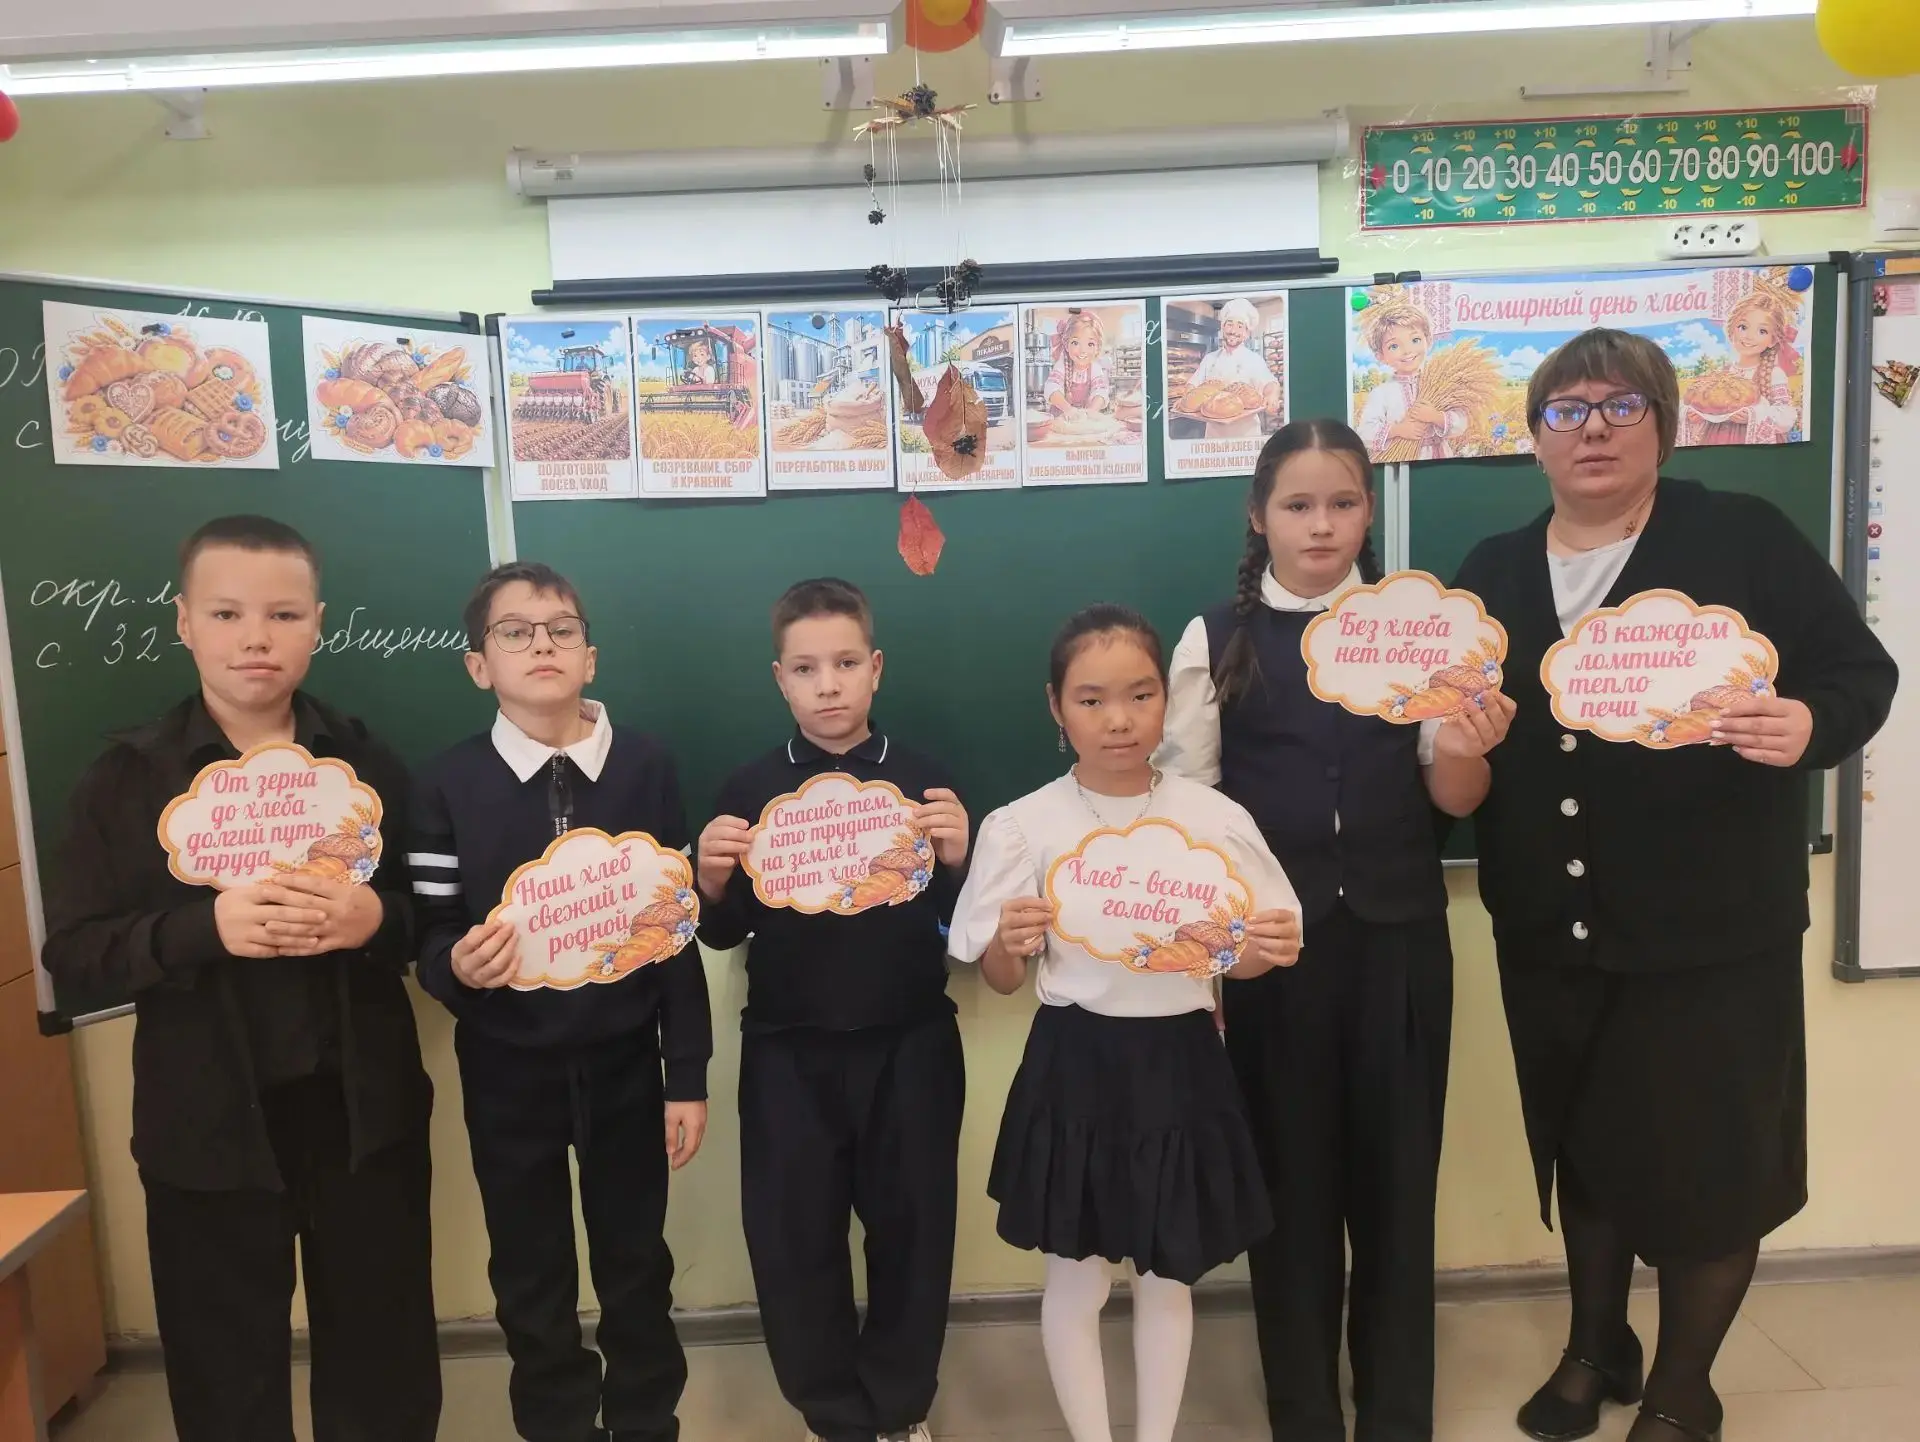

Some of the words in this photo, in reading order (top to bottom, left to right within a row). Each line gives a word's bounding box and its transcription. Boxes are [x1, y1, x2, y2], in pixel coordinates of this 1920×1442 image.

[1412, 132, 1434, 142] +10
[1453, 130, 1475, 140] +10
[1494, 129, 1516, 139] +10
[1534, 127, 1556, 137] +10
[1575, 126, 1597, 136] +10
[1657, 121, 1678, 132] +10
[1695, 120, 1716, 130] +10
[1736, 118, 1758, 128] +10
[1778, 117, 1799, 127] +10
[1393, 160, 1410, 193] 0
[1421, 158, 1451, 191] 10
[1463, 156, 1495, 190] 20
[1505, 154, 1536, 189] 30
[1545, 152, 1579, 187] 40
[1588, 151, 1622, 186] 50
[1628, 149, 1661, 184] 60
[1668, 148, 1700, 182] 70
[1707, 146, 1740, 180] 80
[1746, 144, 1779, 178] 90
[1786, 141, 1834, 176] 100
[1414, 208, 1434, 220] -10
[1456, 208, 1475, 218] -10
[1497, 206, 1516, 216] -10
[1537, 204, 1556, 215] -10
[1578, 203, 1596, 213] -10
[1616, 201, 1636, 211] -10
[1658, 200, 1677, 210] -10
[1696, 198, 1714, 208] -10
[1737, 196, 1756, 206] -10
[1779, 194, 1798, 204] -10
[1455, 290, 1584, 325] Всемирный
[1589, 293, 1638, 323] день
[1645, 283, 1709, 313] хлеба
[1232, 440, 1252, 451] ХЛЕБ
[725, 460, 752, 474] СБОР
[775, 460, 846, 473] ПЕРЕРАБОТКА
[850, 460, 856, 472] В
[858, 459, 886, 472] МУКУ
[541, 478, 578, 490] ПОСЕВ,
[581, 478, 608, 491] УХОД
[672, 476, 678, 488] И
[680, 476, 733, 488] ХРАНЕНИЕ
[1340, 612, 1379, 643] Без
[1384, 612, 1452, 638] хлеба
[1588, 620, 1608, 644] В
[1614, 622, 1729, 648] каждом
[1334, 647, 1380, 664] нет
[1385, 641, 1450, 672] обеда
[1574, 650, 1697, 670] ломтике
[1568, 676, 1652, 695] тепло
[1580, 700, 1640, 718] печи
[212, 770, 250, 794] От
[256, 770, 318, 797] зерна
[211, 804, 240, 828] до
[244, 794, 306, 820] хлеба
[774, 798, 844, 828] Спасибо
[848, 796, 893, 814] тем,
[186, 822, 266, 856] долгий
[270, 821, 326, 847] путь
[770, 830, 806, 849] кто
[810, 812, 904, 844] трудится
[194, 850, 272, 876] труда
[762, 855, 784, 873] на
[789, 845, 843, 873] земле
[848, 842, 859, 857] и
[516, 874, 576, 906] Наш
[580, 845, 632, 886] хлеб
[764, 872, 824, 900] дарит
[828, 856, 869, 882] хлеб
[1068, 859, 1128, 888] Хлеб
[1146, 870, 1218, 909] всему
[528, 883, 618, 933] свежий
[622, 882, 638, 900] и
[1102, 899, 1182, 925] голова
[549, 908, 631, 964] родной
